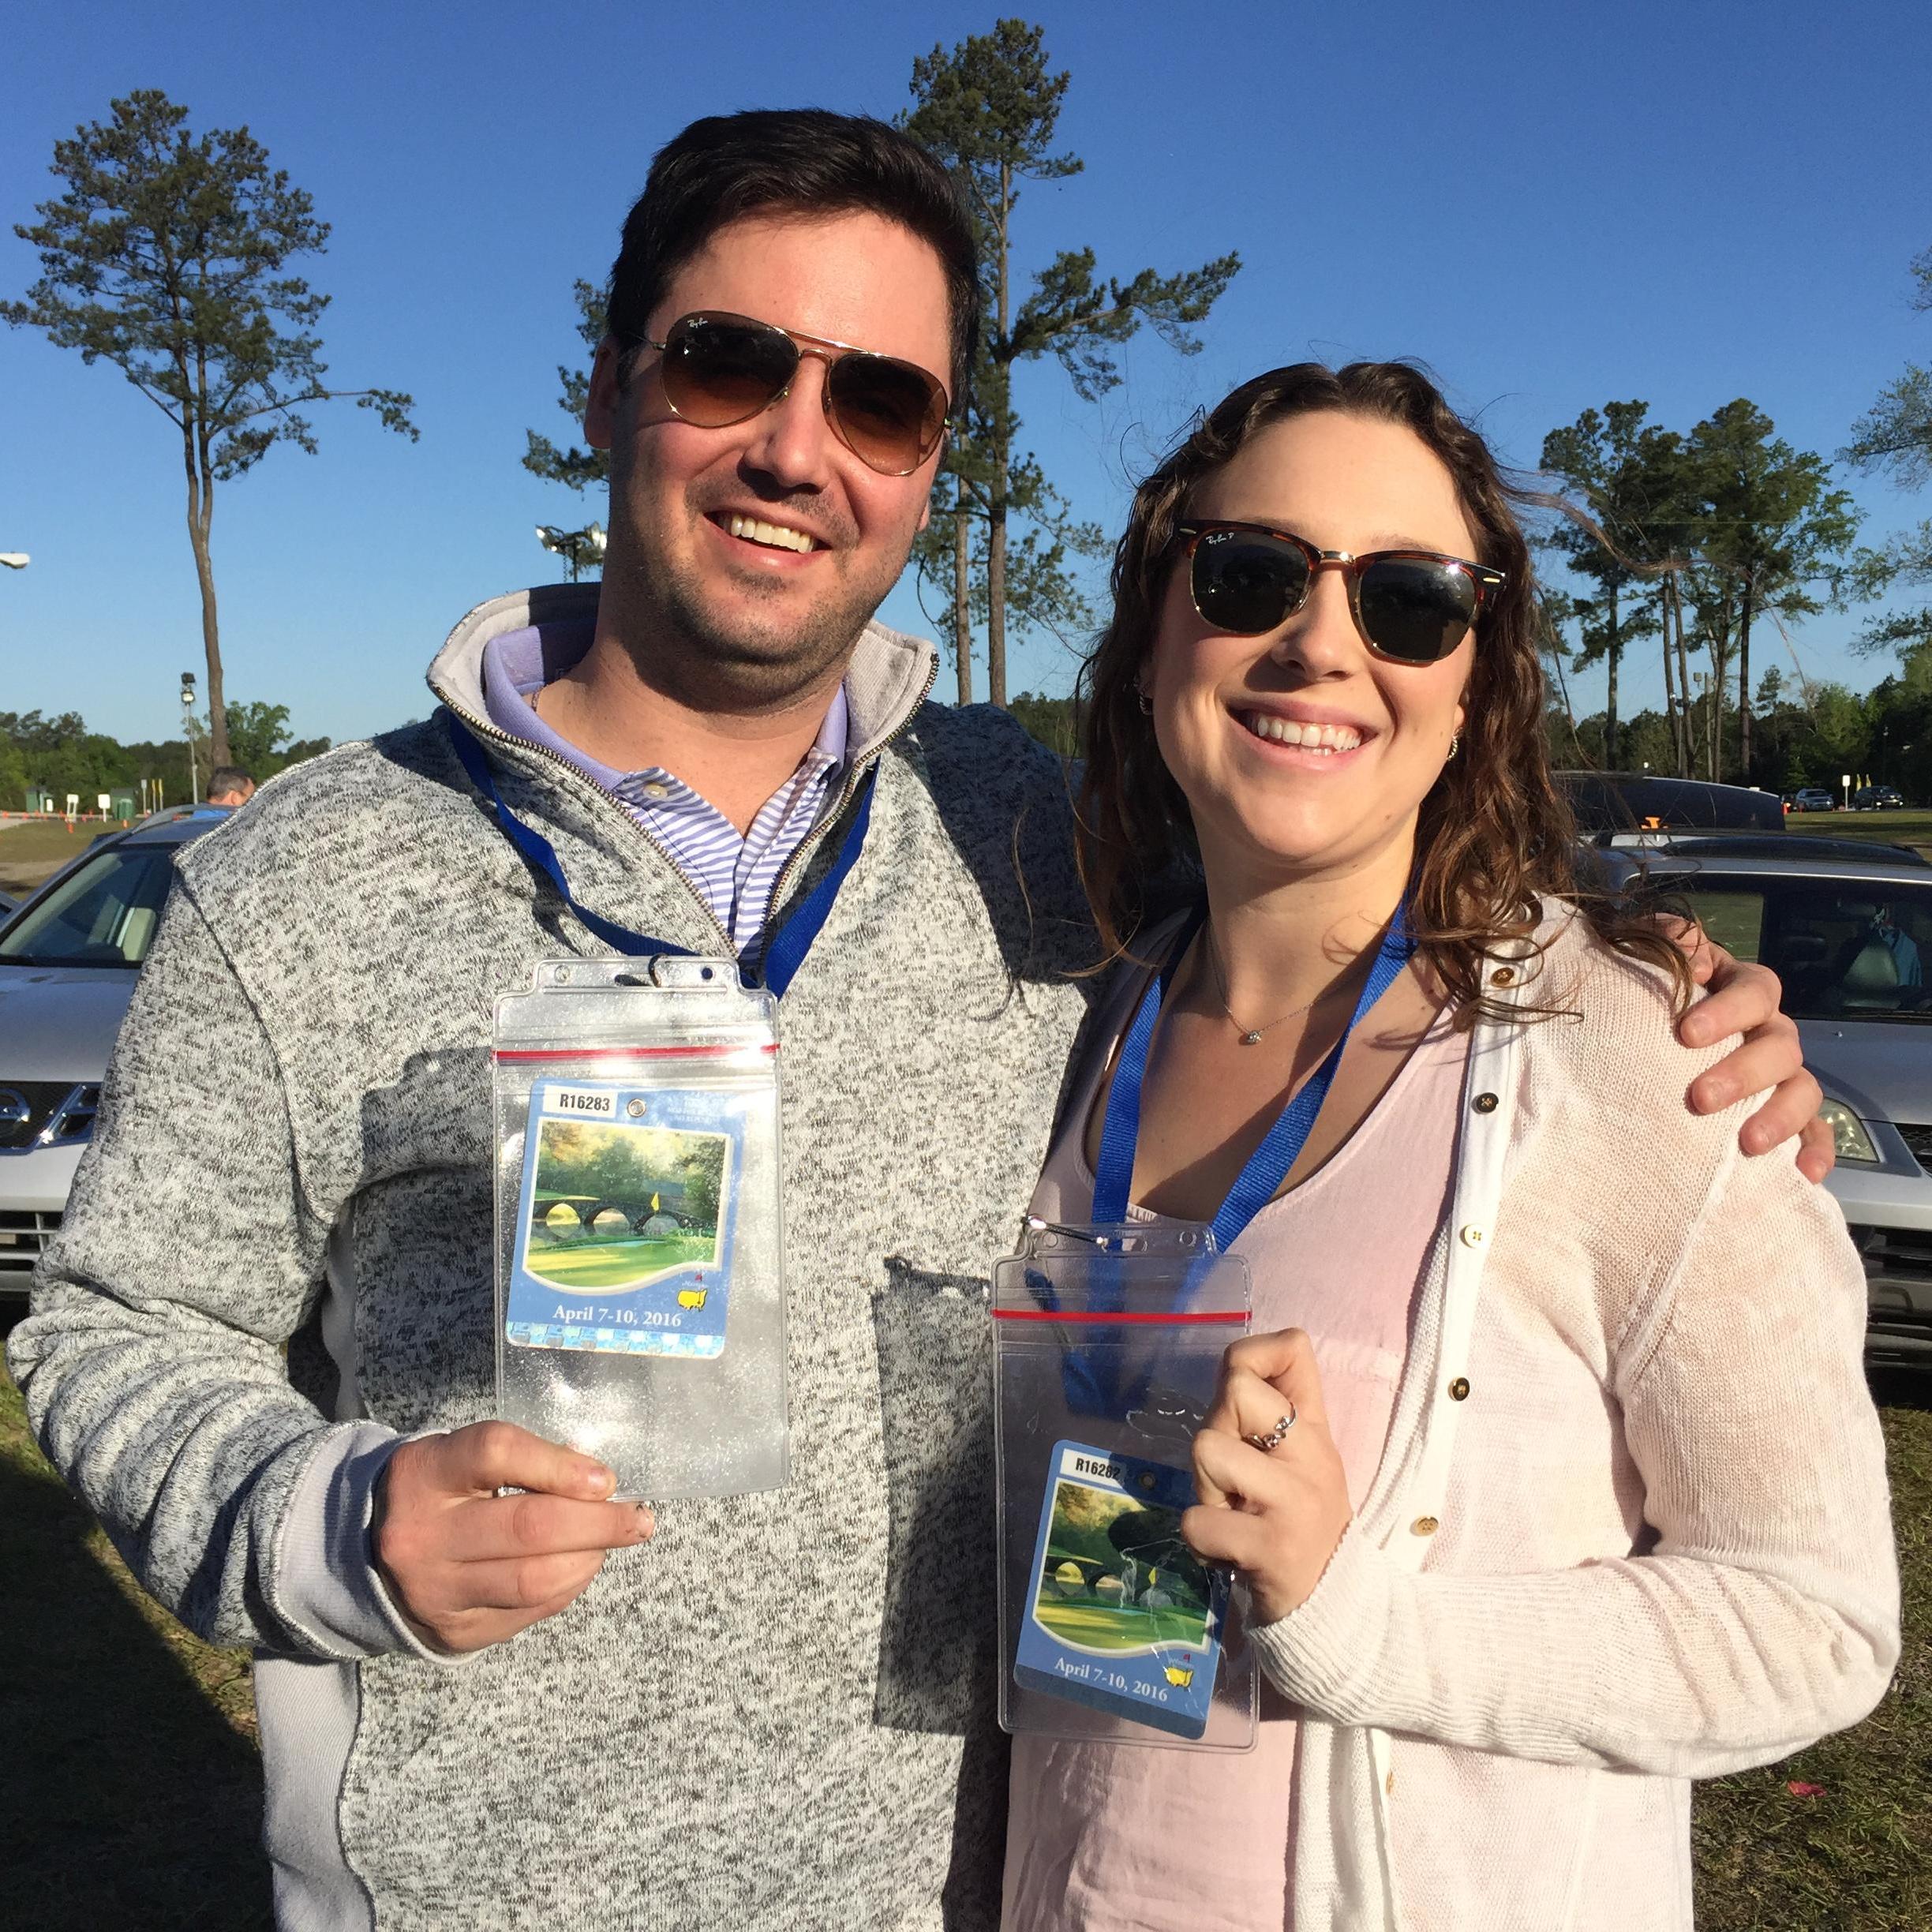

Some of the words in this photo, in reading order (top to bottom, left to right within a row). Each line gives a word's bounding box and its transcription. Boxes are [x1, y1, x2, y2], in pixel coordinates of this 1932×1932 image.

[560, 1094, 610, 1111] R16283
[552, 1305, 593, 1324] April
[598, 1308, 638, 1326] 7-10,
[642, 1311, 682, 1327] 2016
[1075, 1457, 1121, 1481] R16282
[1054, 1657, 1091, 1679] April
[1094, 1668, 1129, 1693] 7-10,
[1133, 1680, 1169, 1702] 2016
